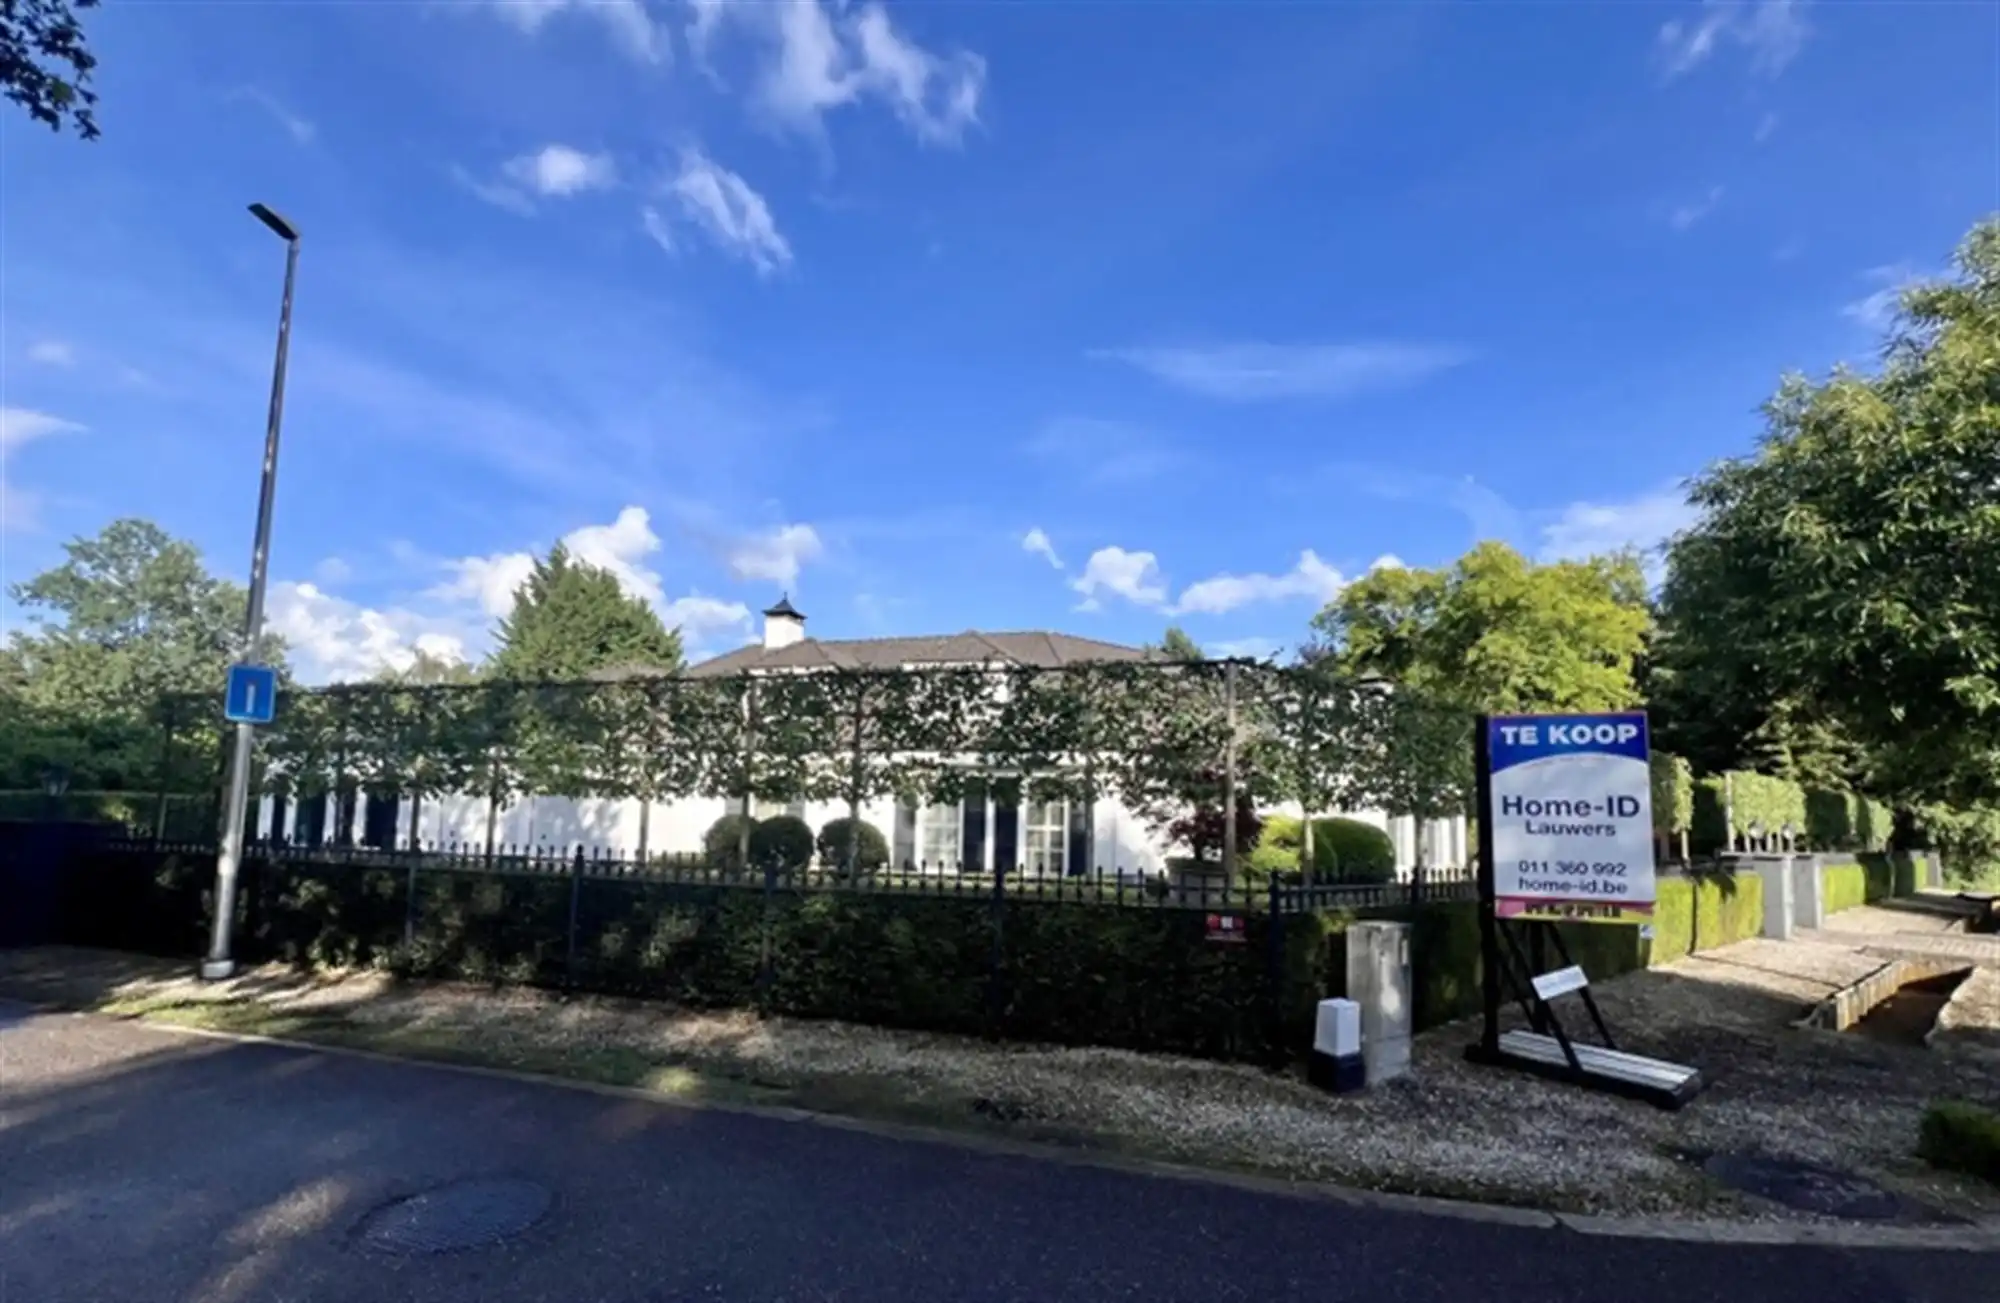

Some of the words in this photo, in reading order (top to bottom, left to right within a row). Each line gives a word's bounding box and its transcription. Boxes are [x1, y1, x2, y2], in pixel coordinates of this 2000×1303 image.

[1501, 725, 1539, 745] TE
[1549, 724, 1638, 745] KOOP
[1502, 795, 1640, 818] Home-ID
[1525, 820, 1616, 837] Lauwers
[1518, 860, 1549, 874] 011
[1556, 861, 1588, 875] 360
[1592, 862, 1627, 876] 992
[1518, 876, 1628, 894] home-id.be
